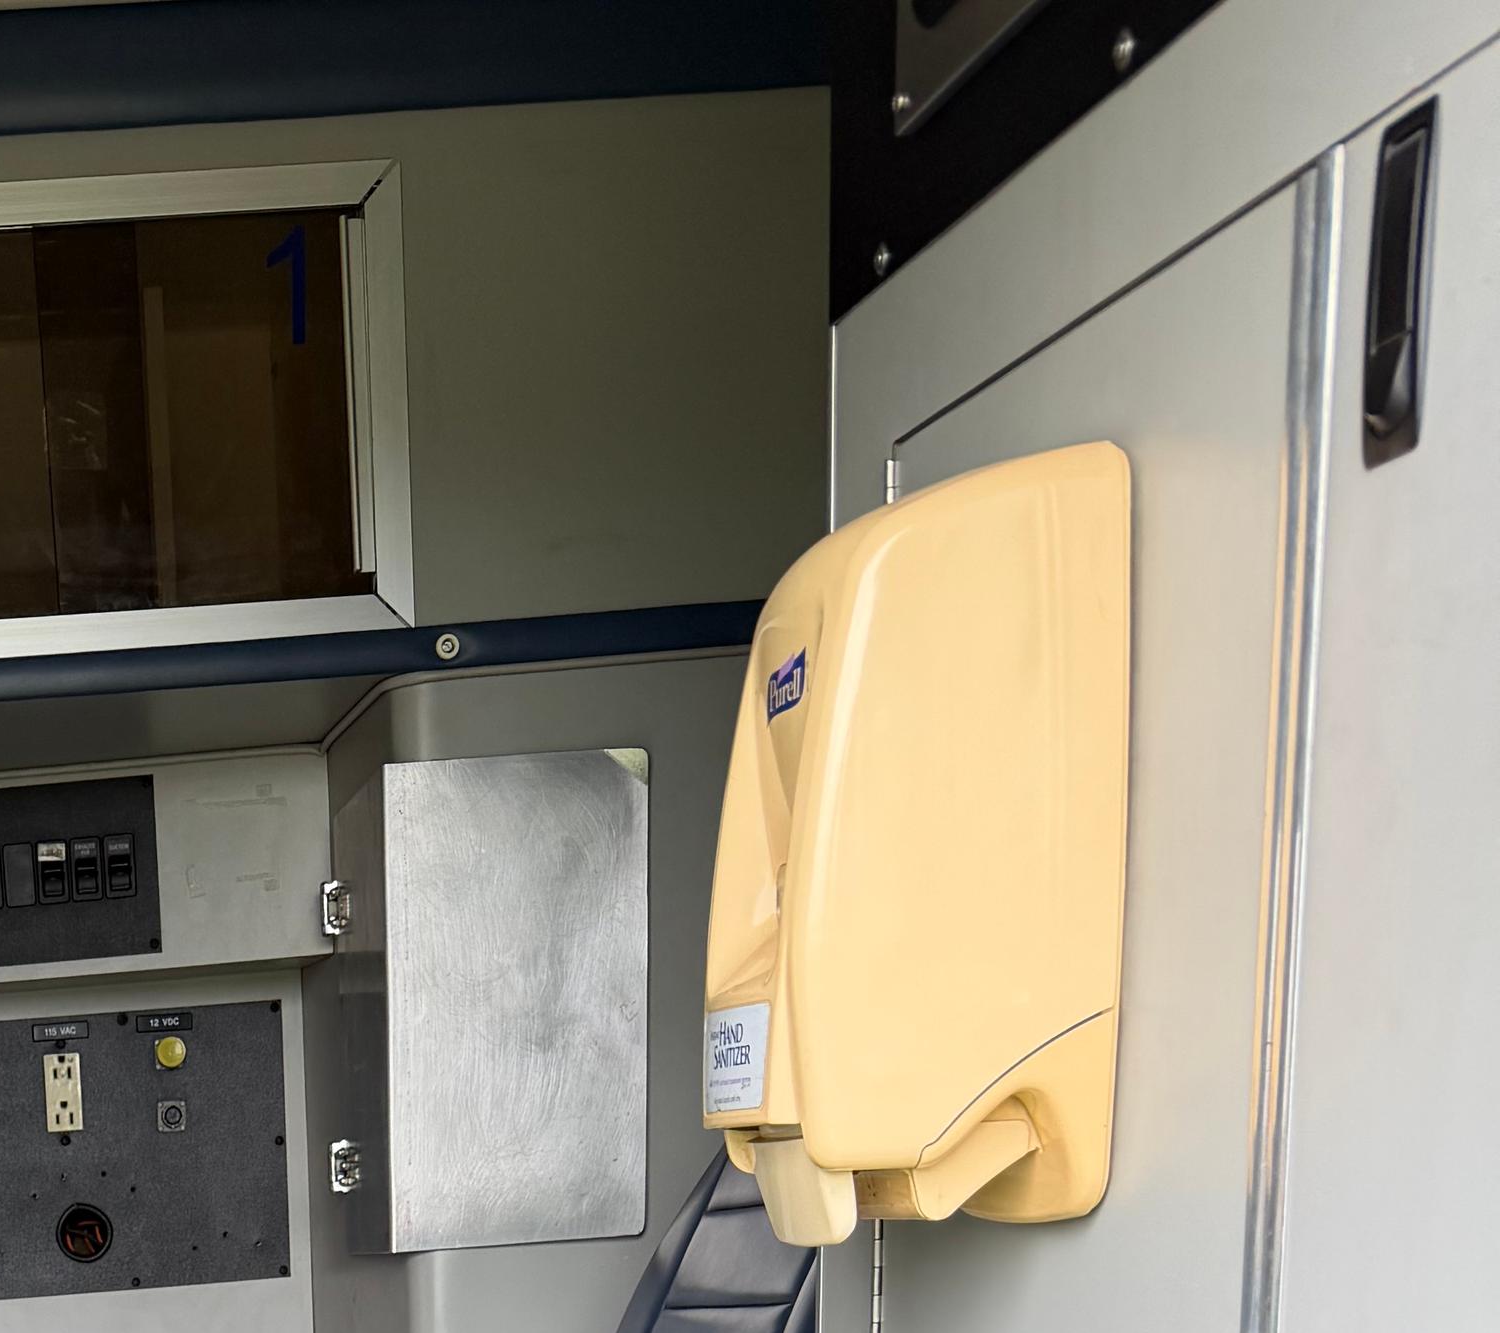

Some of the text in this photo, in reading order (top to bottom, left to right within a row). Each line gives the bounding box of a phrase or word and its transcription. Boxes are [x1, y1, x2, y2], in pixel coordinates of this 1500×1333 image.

[266, 226, 307, 346] 1
[769, 667, 802, 712] Purell
[44, 1026, 77, 1037] 115 VAC
[149, 1017, 180, 1028] 12 VDC
[719, 1021, 743, 1046] HAND
[713, 1044, 751, 1070] SANITIZER
